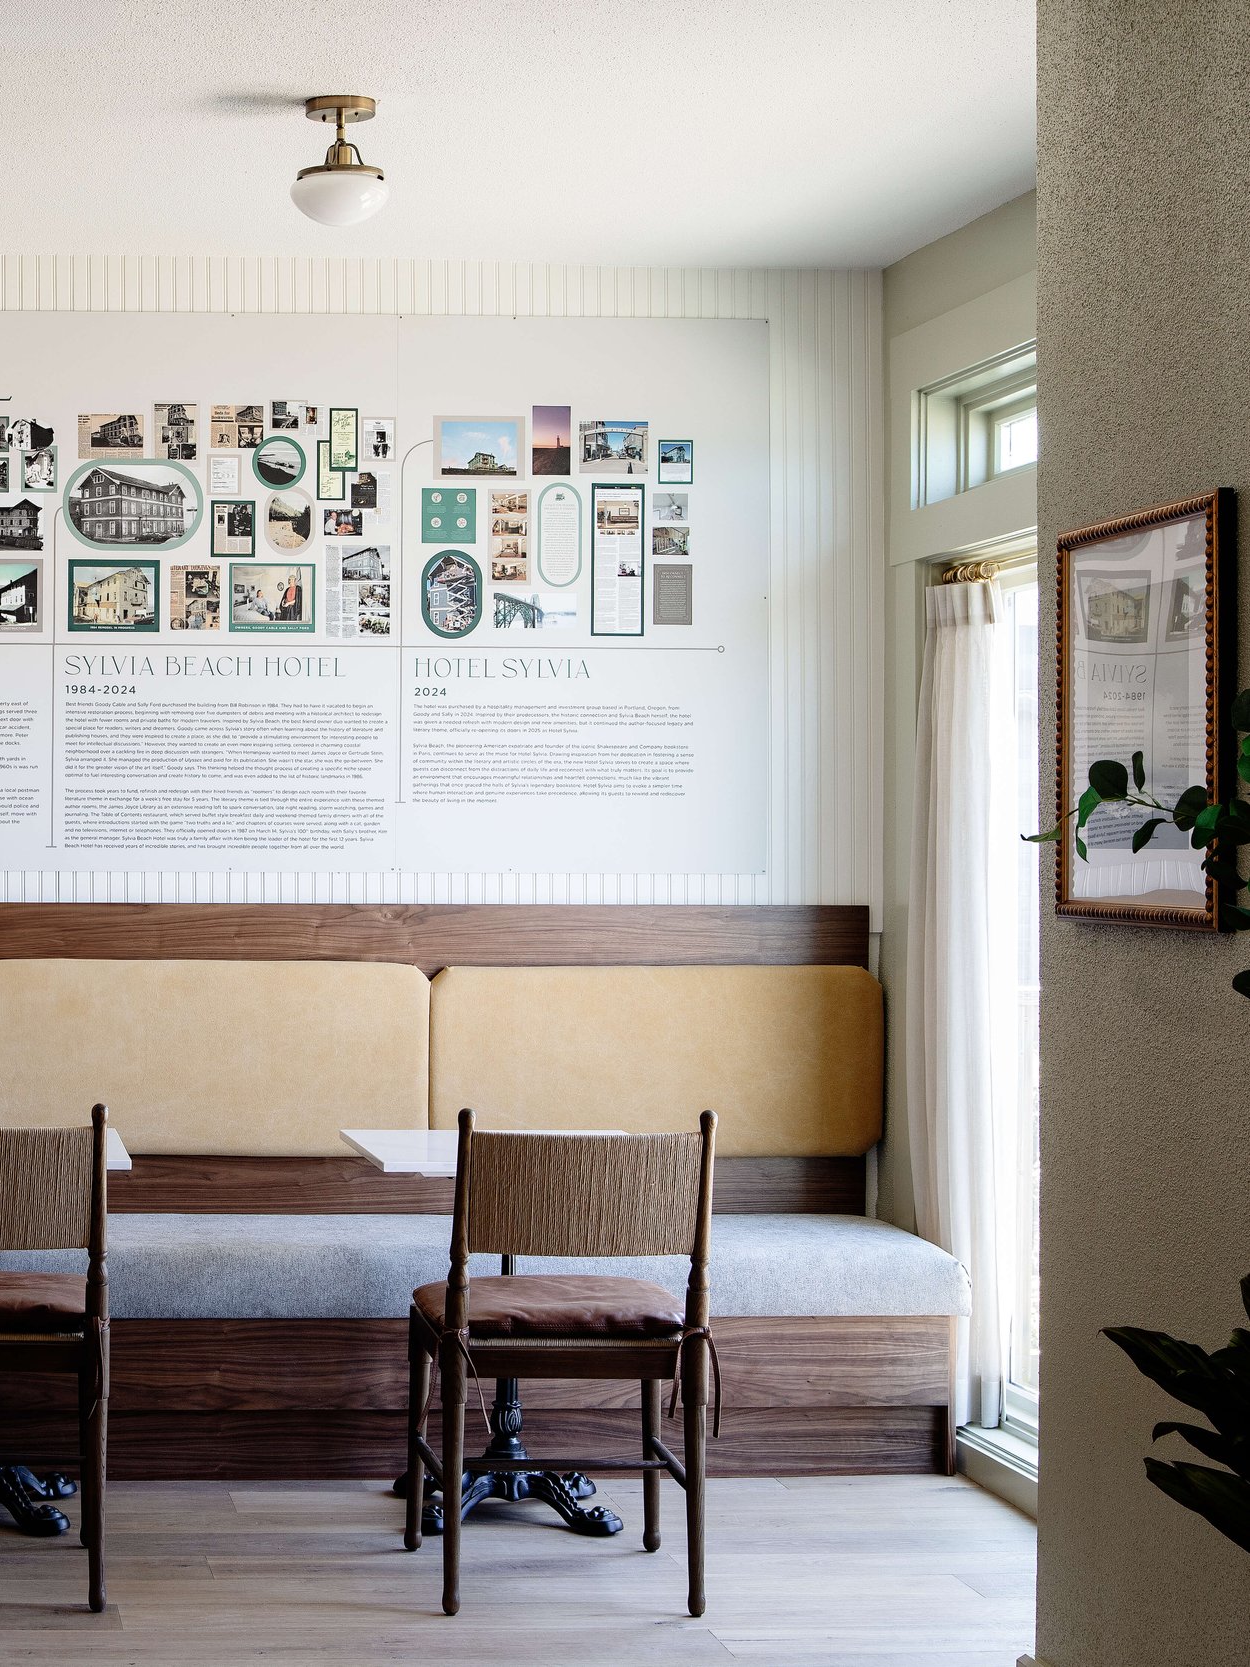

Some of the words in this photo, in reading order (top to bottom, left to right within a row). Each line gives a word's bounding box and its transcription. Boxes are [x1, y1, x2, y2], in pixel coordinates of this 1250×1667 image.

[65, 656, 154, 675] SYLVIA
[166, 657, 251, 676] BEACH
[266, 657, 346, 676] HOTEL
[416, 658, 495, 677] HOTEL
[502, 659, 590, 678] SYLVIA
[66, 685, 135, 694] 1984-2024
[415, 688, 446, 696] 2024
